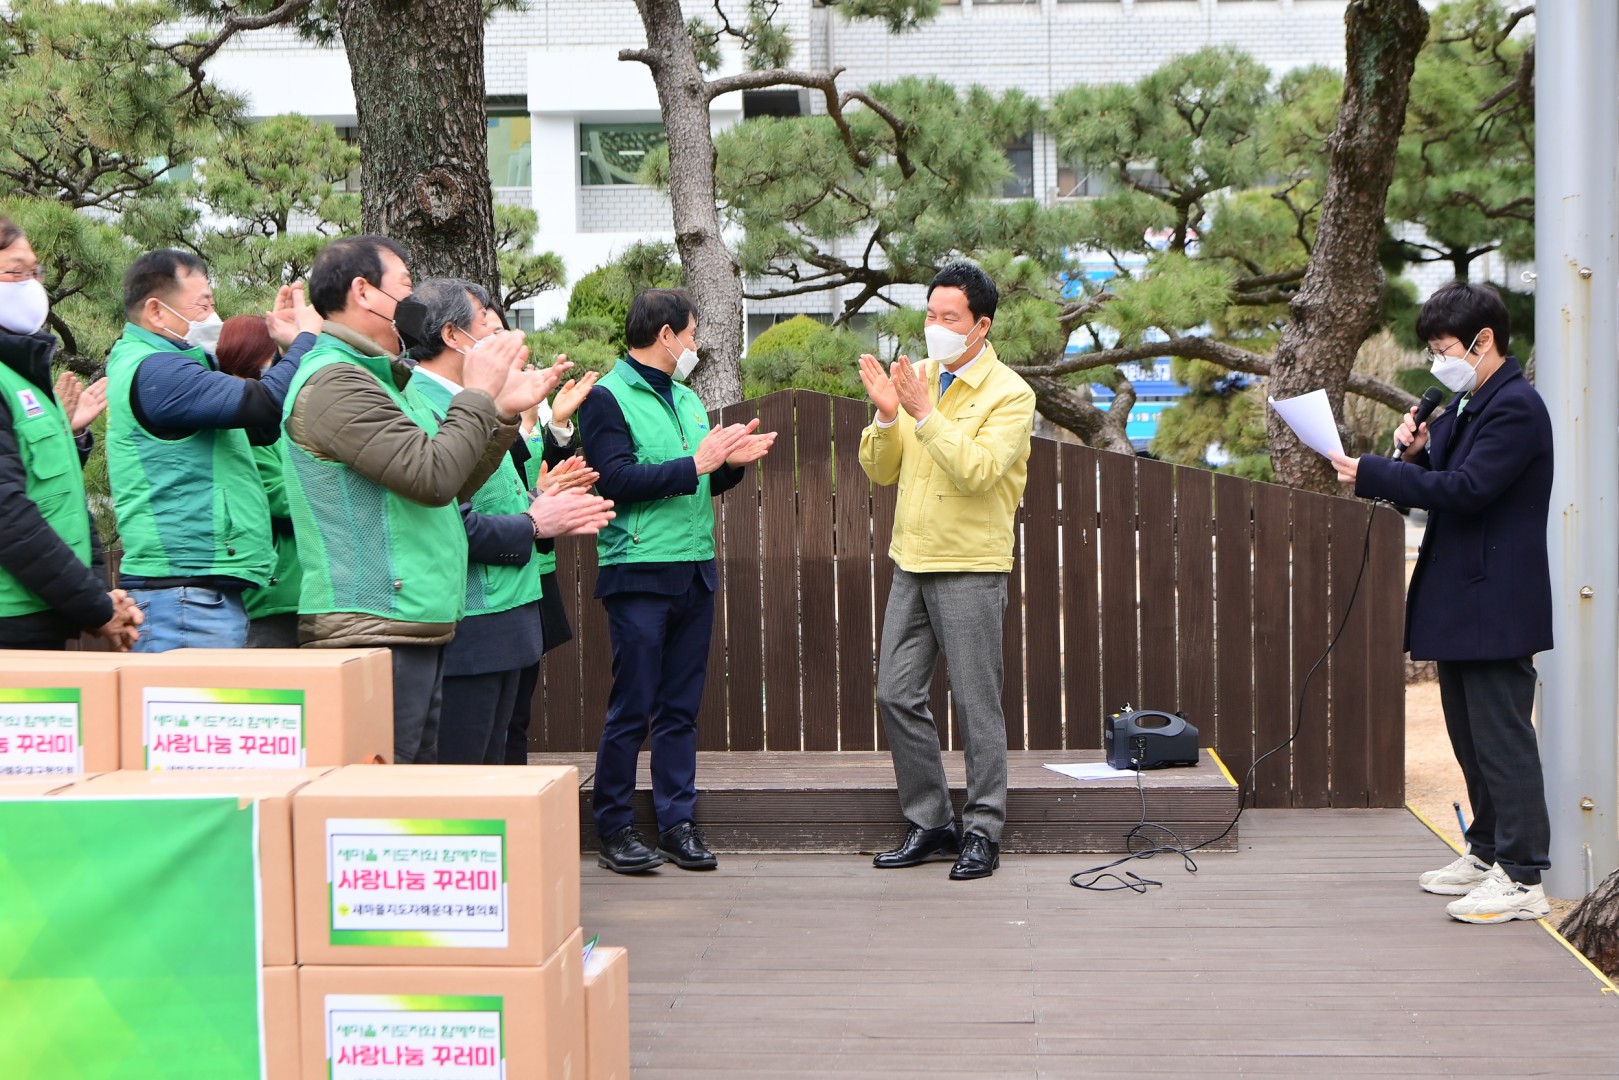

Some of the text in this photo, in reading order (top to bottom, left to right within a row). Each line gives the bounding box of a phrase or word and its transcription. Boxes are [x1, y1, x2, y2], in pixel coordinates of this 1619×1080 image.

[16, 734, 74, 754] 꾸러미
[153, 733, 297, 756] 사랑나눔 꾸러미
[337, 868, 497, 891] 사랑나눔 꾸러미
[336, 1045, 496, 1067] 사랑나눔 꾸러미
